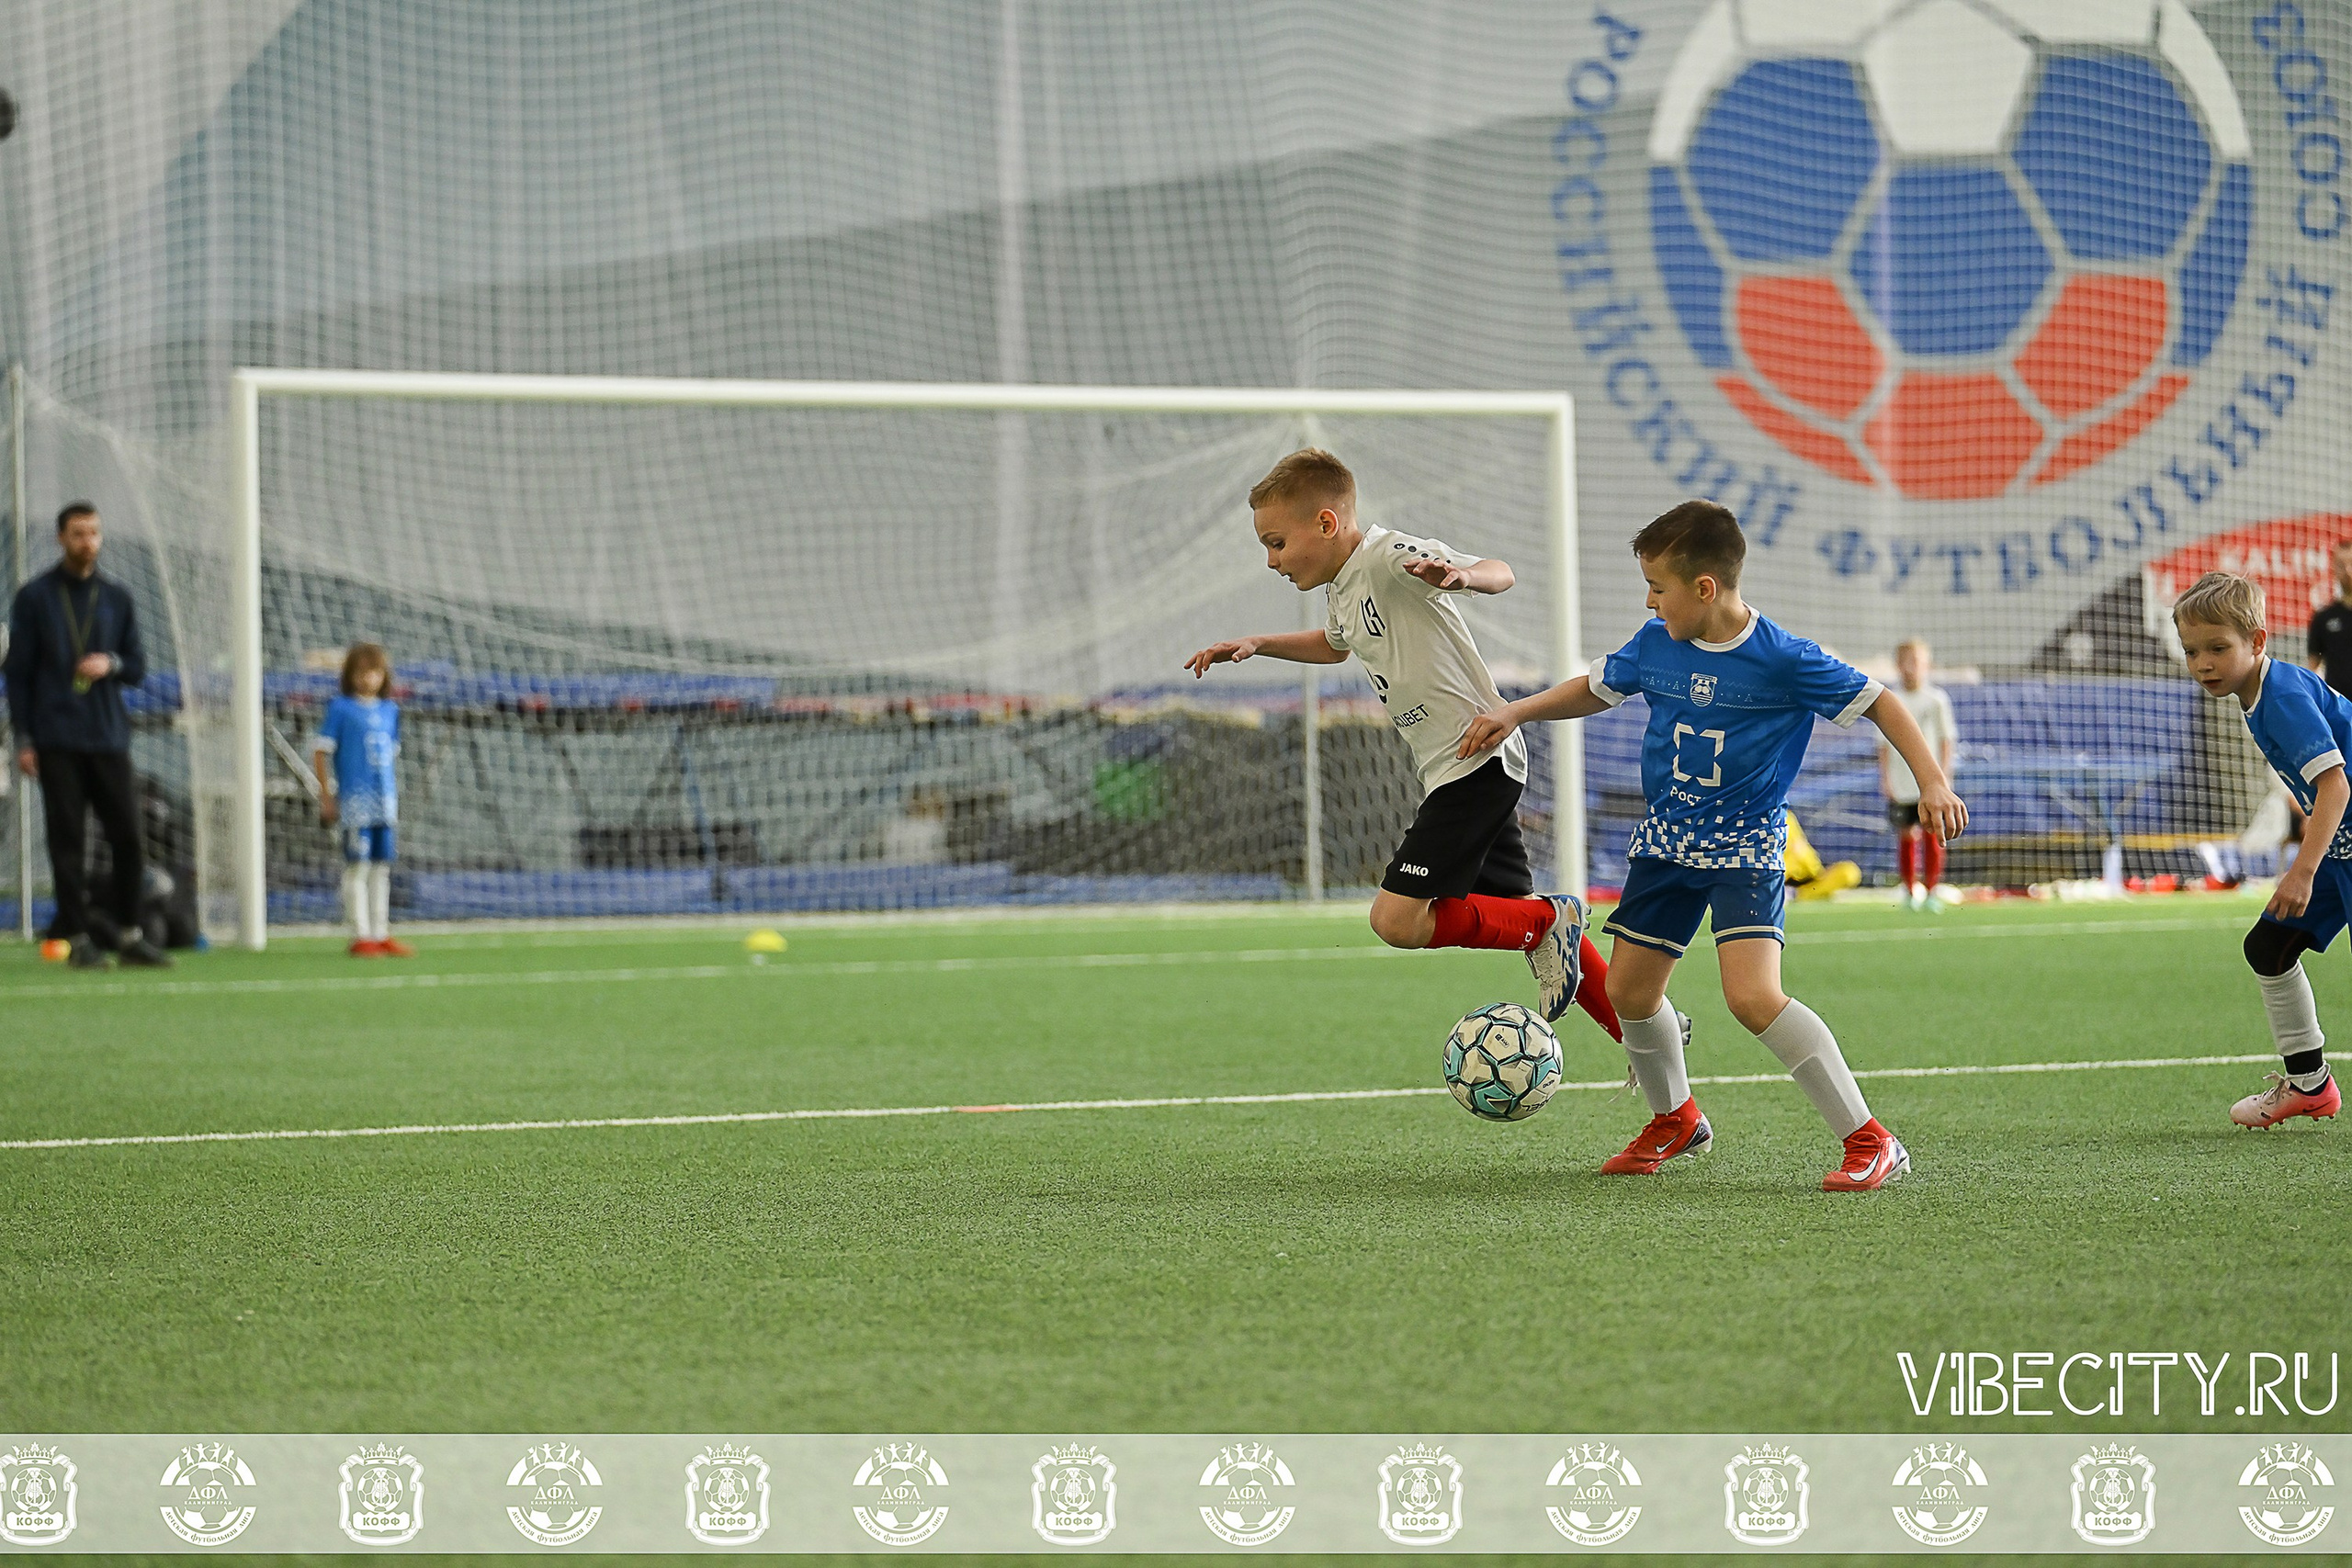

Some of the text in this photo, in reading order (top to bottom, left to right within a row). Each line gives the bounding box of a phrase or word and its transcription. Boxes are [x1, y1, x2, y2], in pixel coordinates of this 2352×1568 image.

[1550, 2, 2346, 596] РОССИЙСКИЙ ФУТБОЛЬНЫЙ СОЮЗ
[1399, 862, 1430, 877] JAKO
